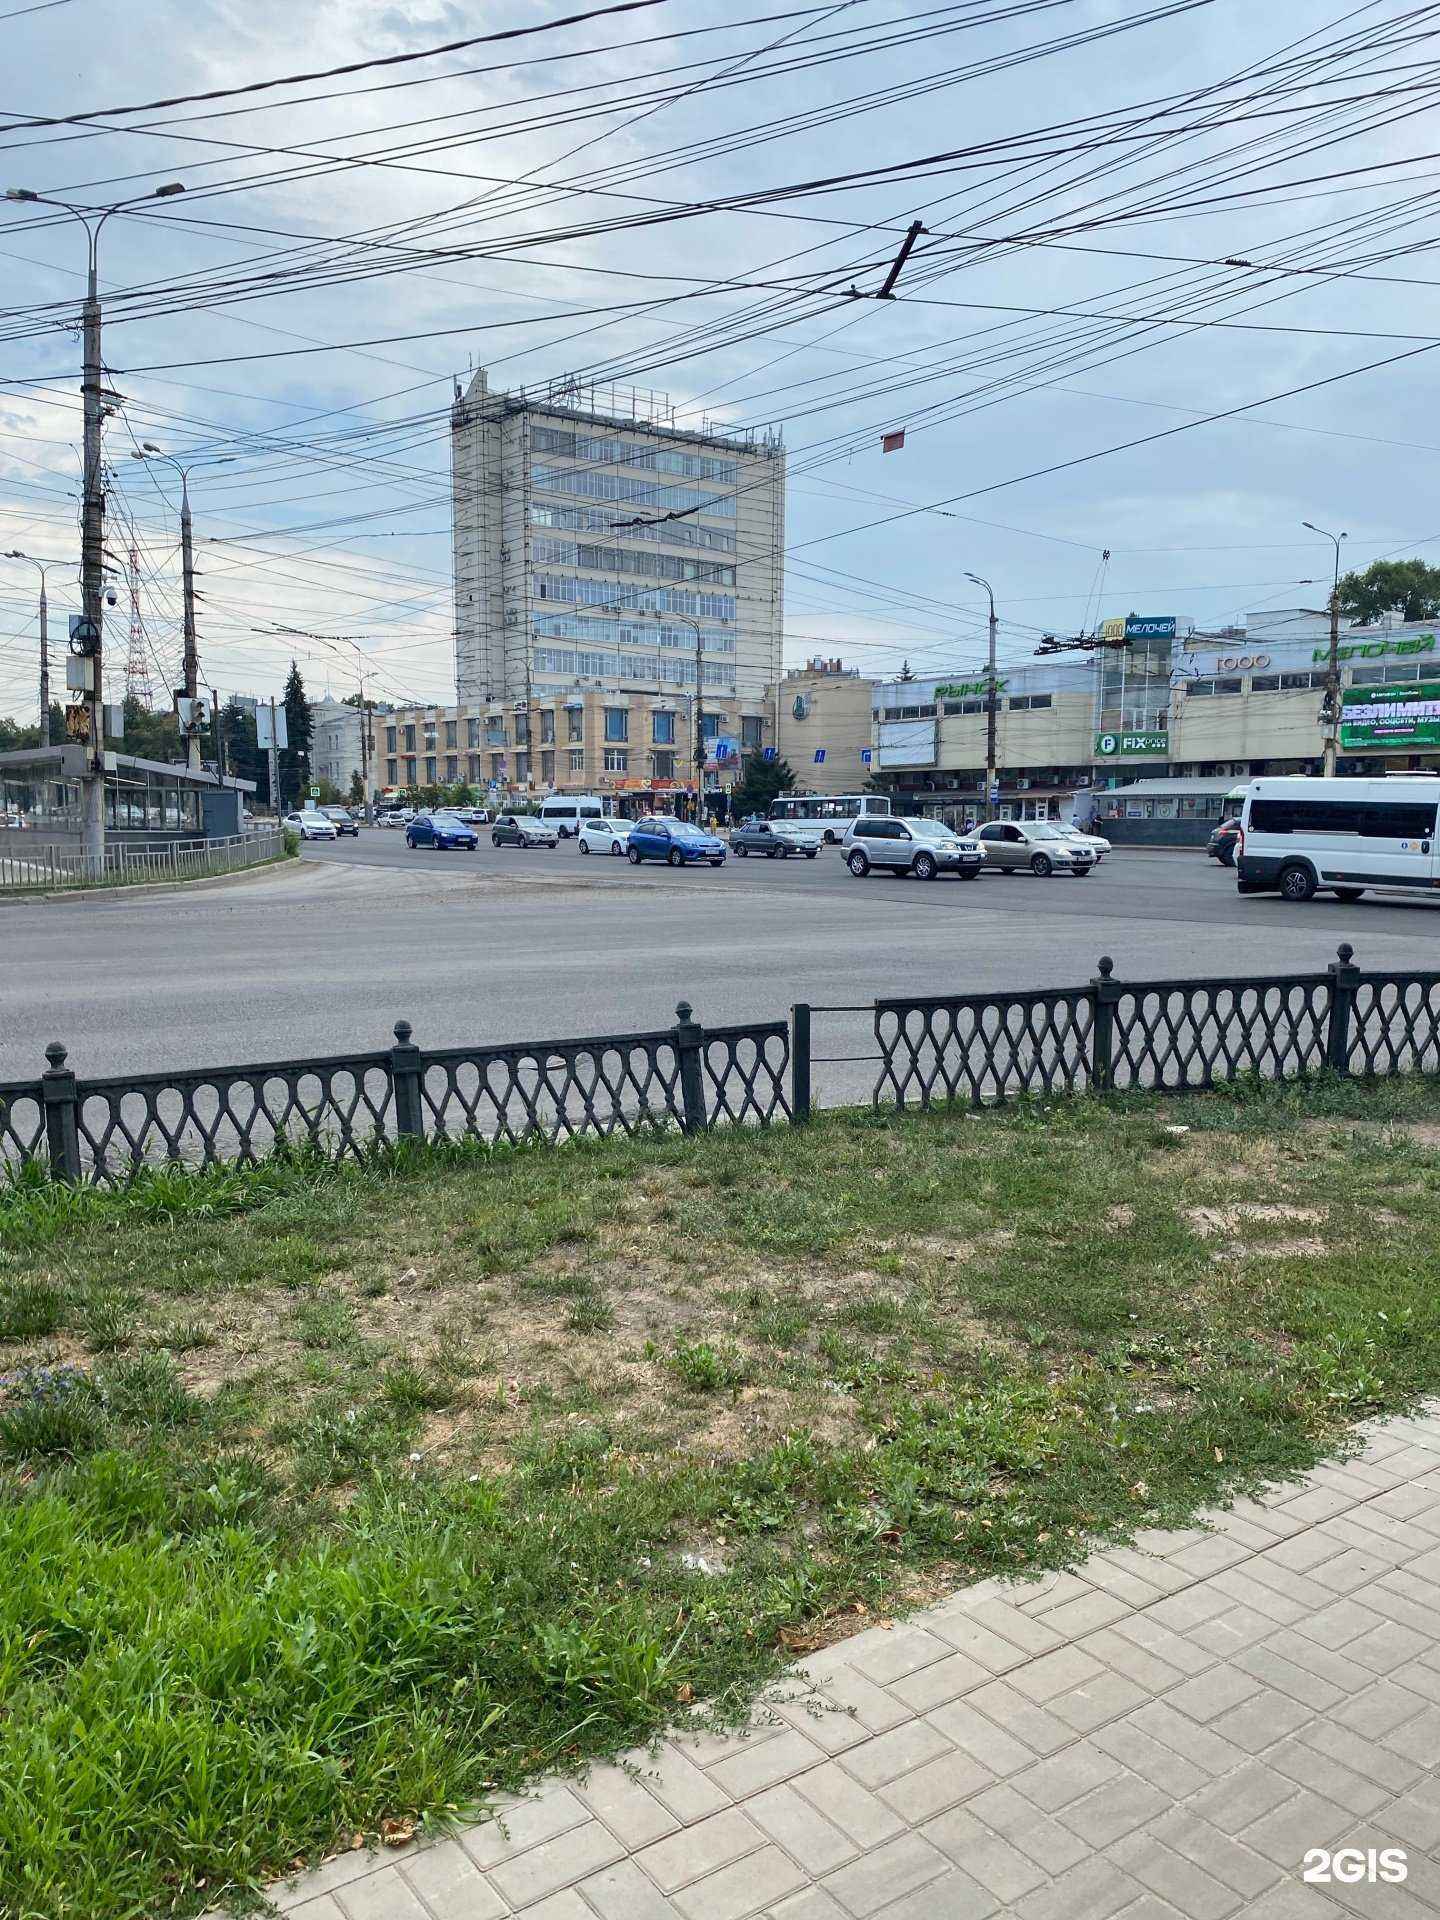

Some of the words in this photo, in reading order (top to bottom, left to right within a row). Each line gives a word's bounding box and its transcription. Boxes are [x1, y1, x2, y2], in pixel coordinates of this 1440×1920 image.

[1126, 618, 1175, 634] МЕЛОЧЕЙ
[1217, 654, 1270, 672] 1000
[1123, 737, 1146, 749] FIX
